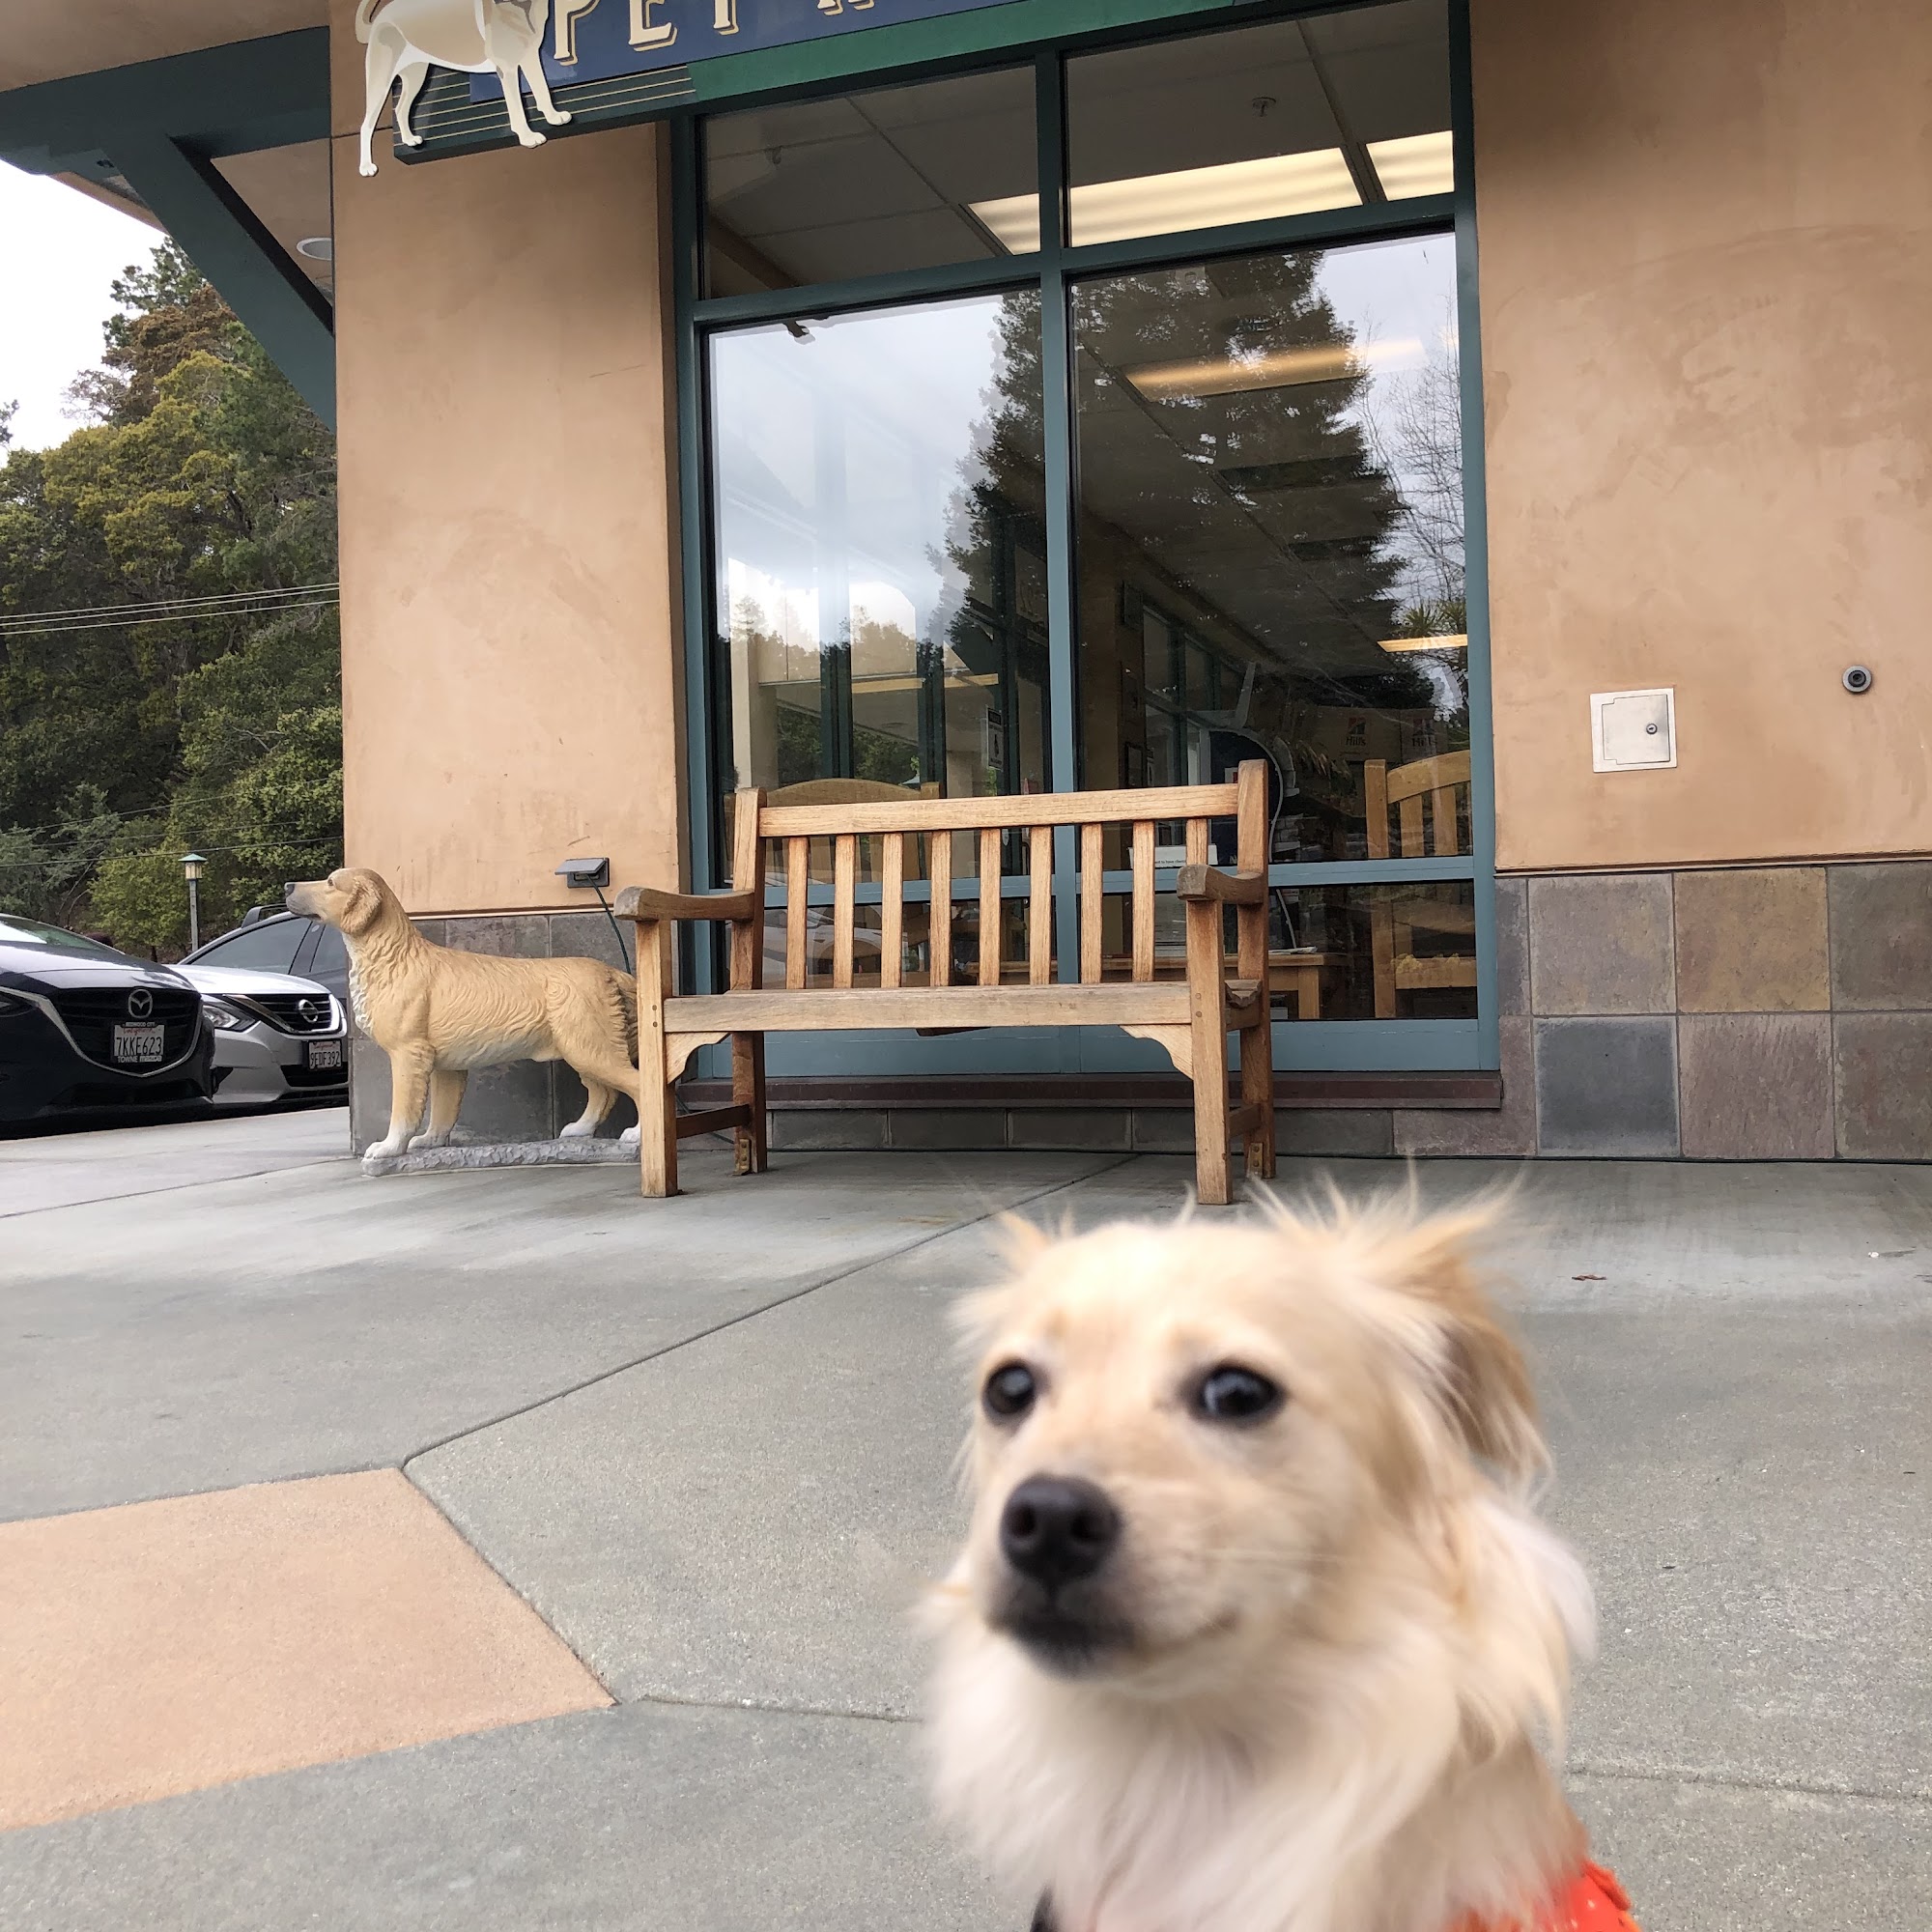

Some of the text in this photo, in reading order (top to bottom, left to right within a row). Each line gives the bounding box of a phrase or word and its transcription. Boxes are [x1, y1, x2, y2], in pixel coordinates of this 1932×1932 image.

[1346, 736, 1367, 747] Hill's
[116, 1037, 162, 1055] 7KKE623
[310, 1051, 340, 1067] 9EDF392
